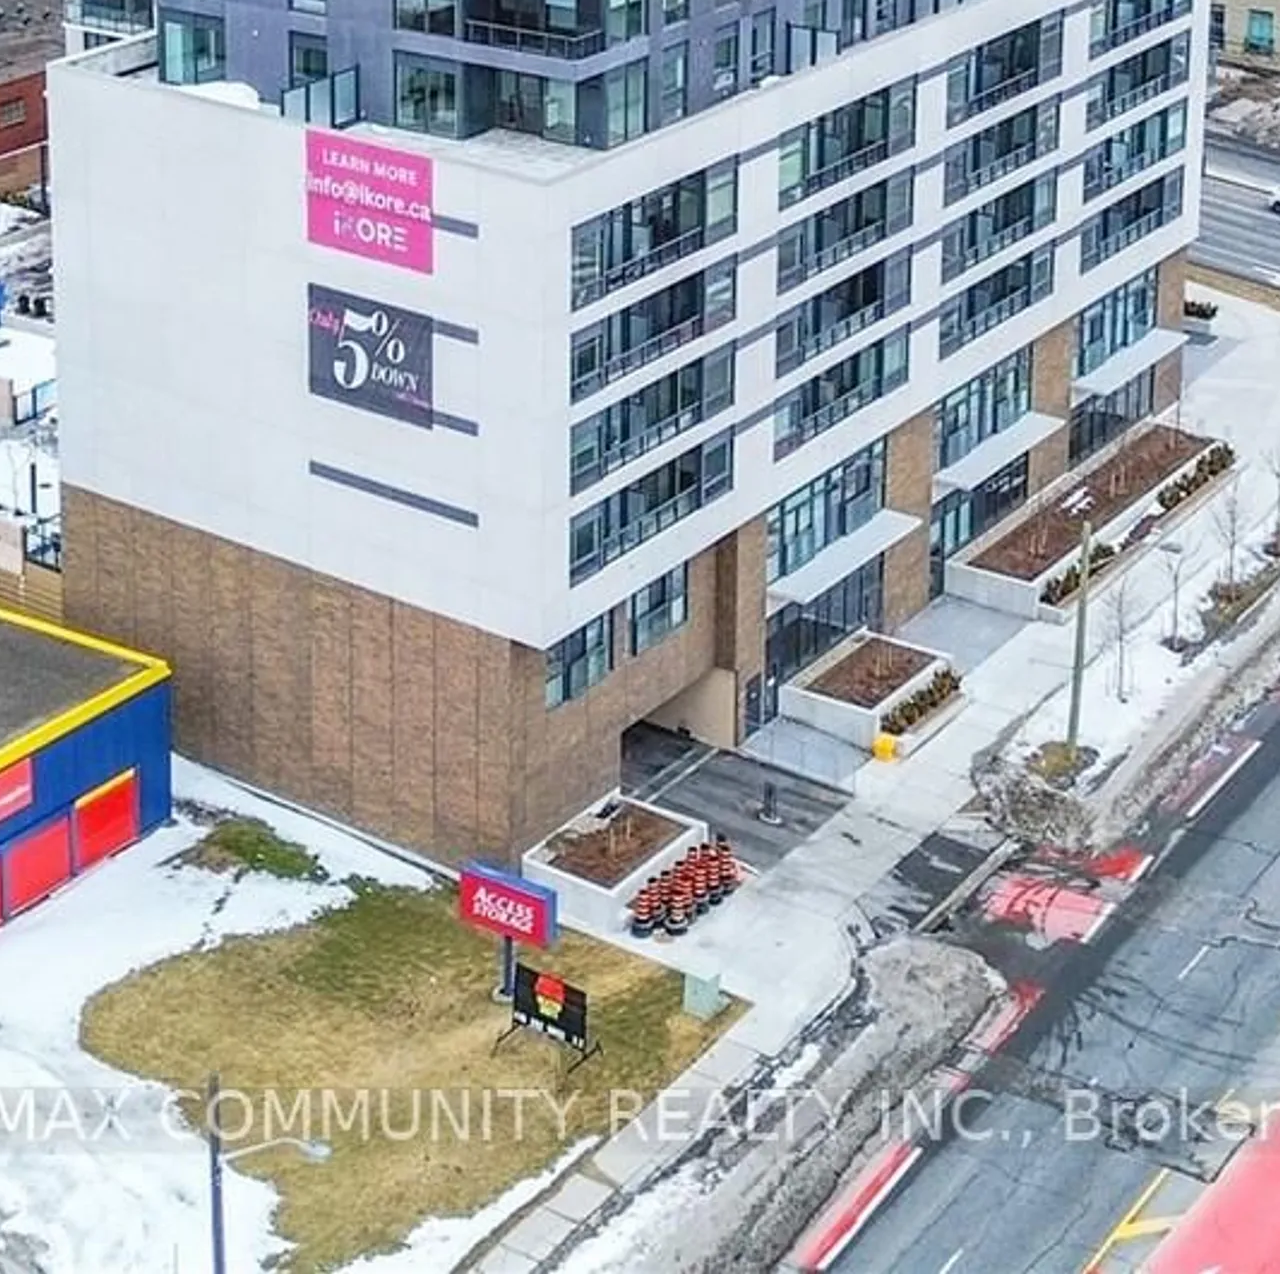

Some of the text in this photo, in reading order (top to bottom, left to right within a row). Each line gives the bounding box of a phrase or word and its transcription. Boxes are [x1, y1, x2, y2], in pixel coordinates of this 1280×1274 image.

[321, 147, 419, 187] LEARN MORE
[333, 308, 406, 390] 5%
[471, 886, 535, 922] ACCESS
